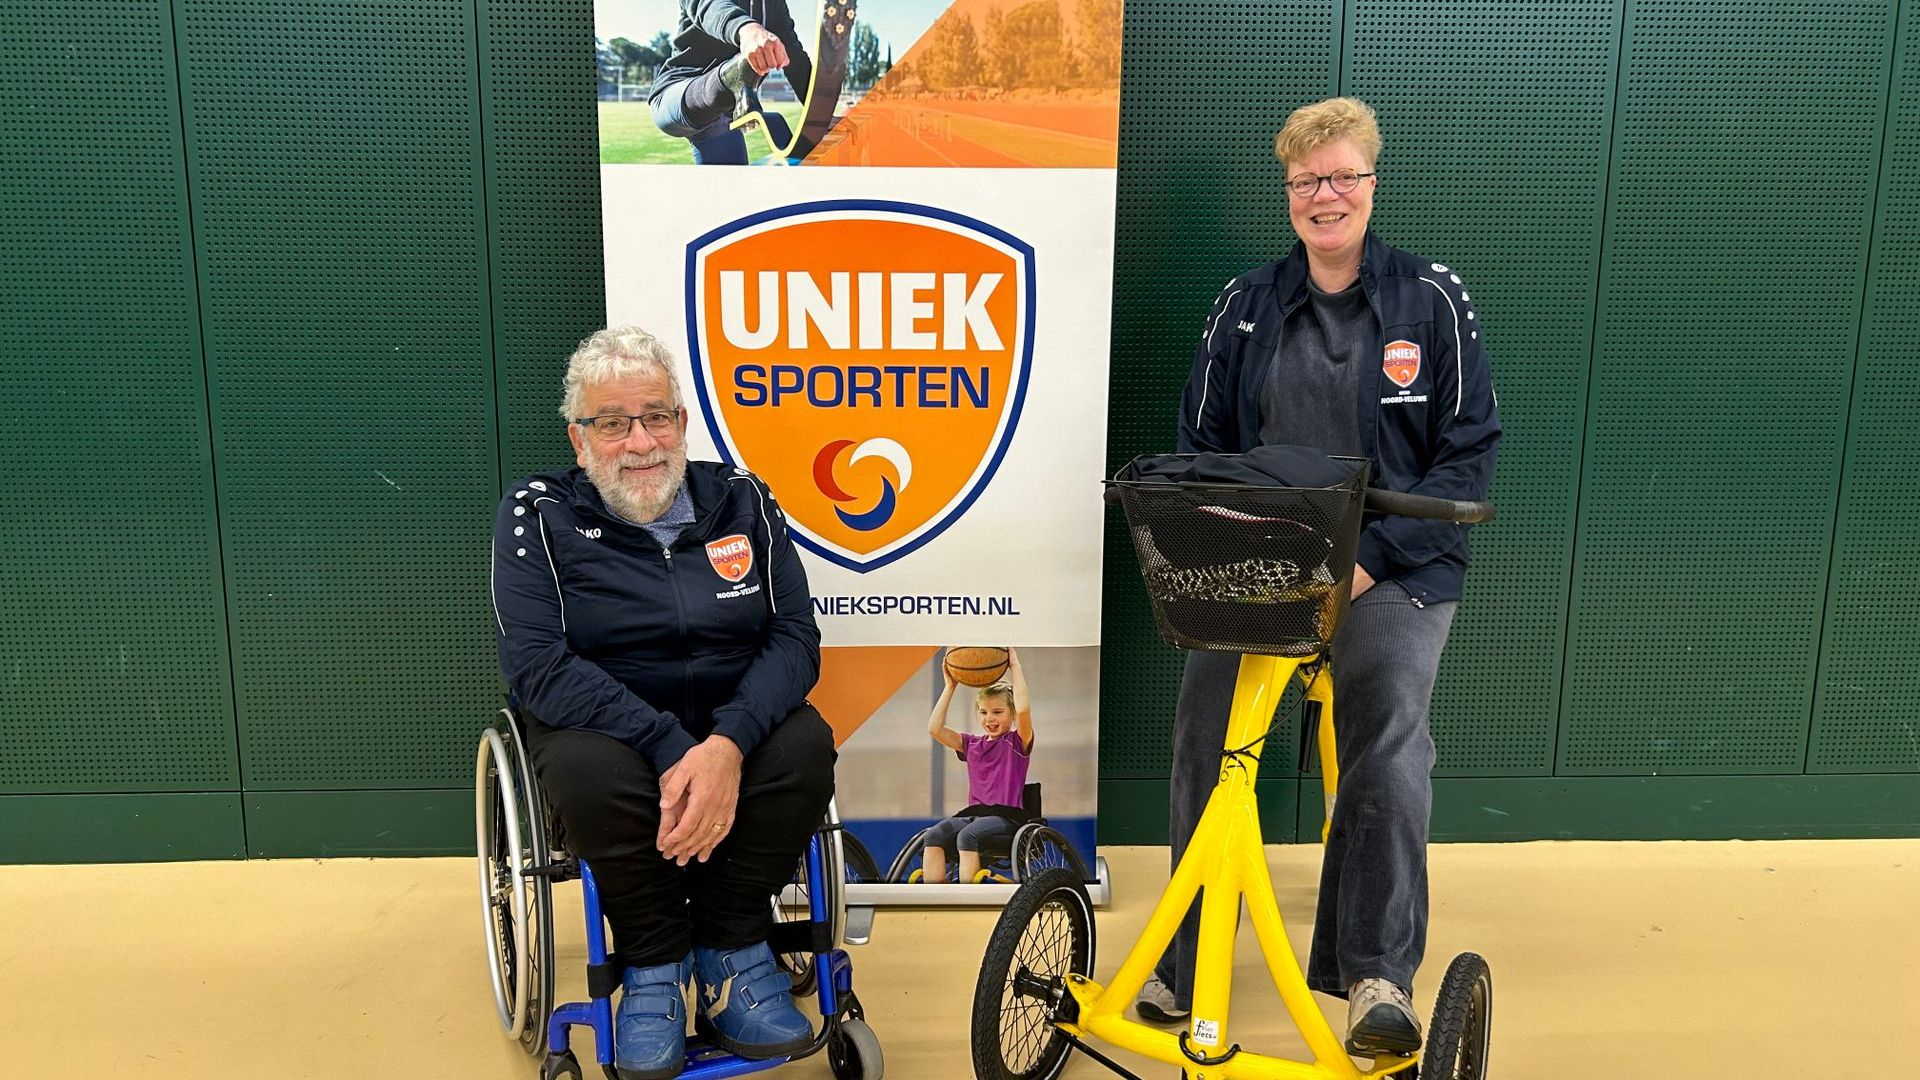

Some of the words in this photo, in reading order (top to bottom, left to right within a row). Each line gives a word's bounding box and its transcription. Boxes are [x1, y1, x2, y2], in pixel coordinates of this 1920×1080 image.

[719, 269, 1006, 351] UNIEK
[1237, 319, 1256, 333] JAK
[733, 364, 990, 409] SPORTEN
[708, 538, 749, 558] UNIEK
[712, 550, 749, 565] SPORTEN
[810, 596, 1021, 616] NIEKSPORTEN.NL
